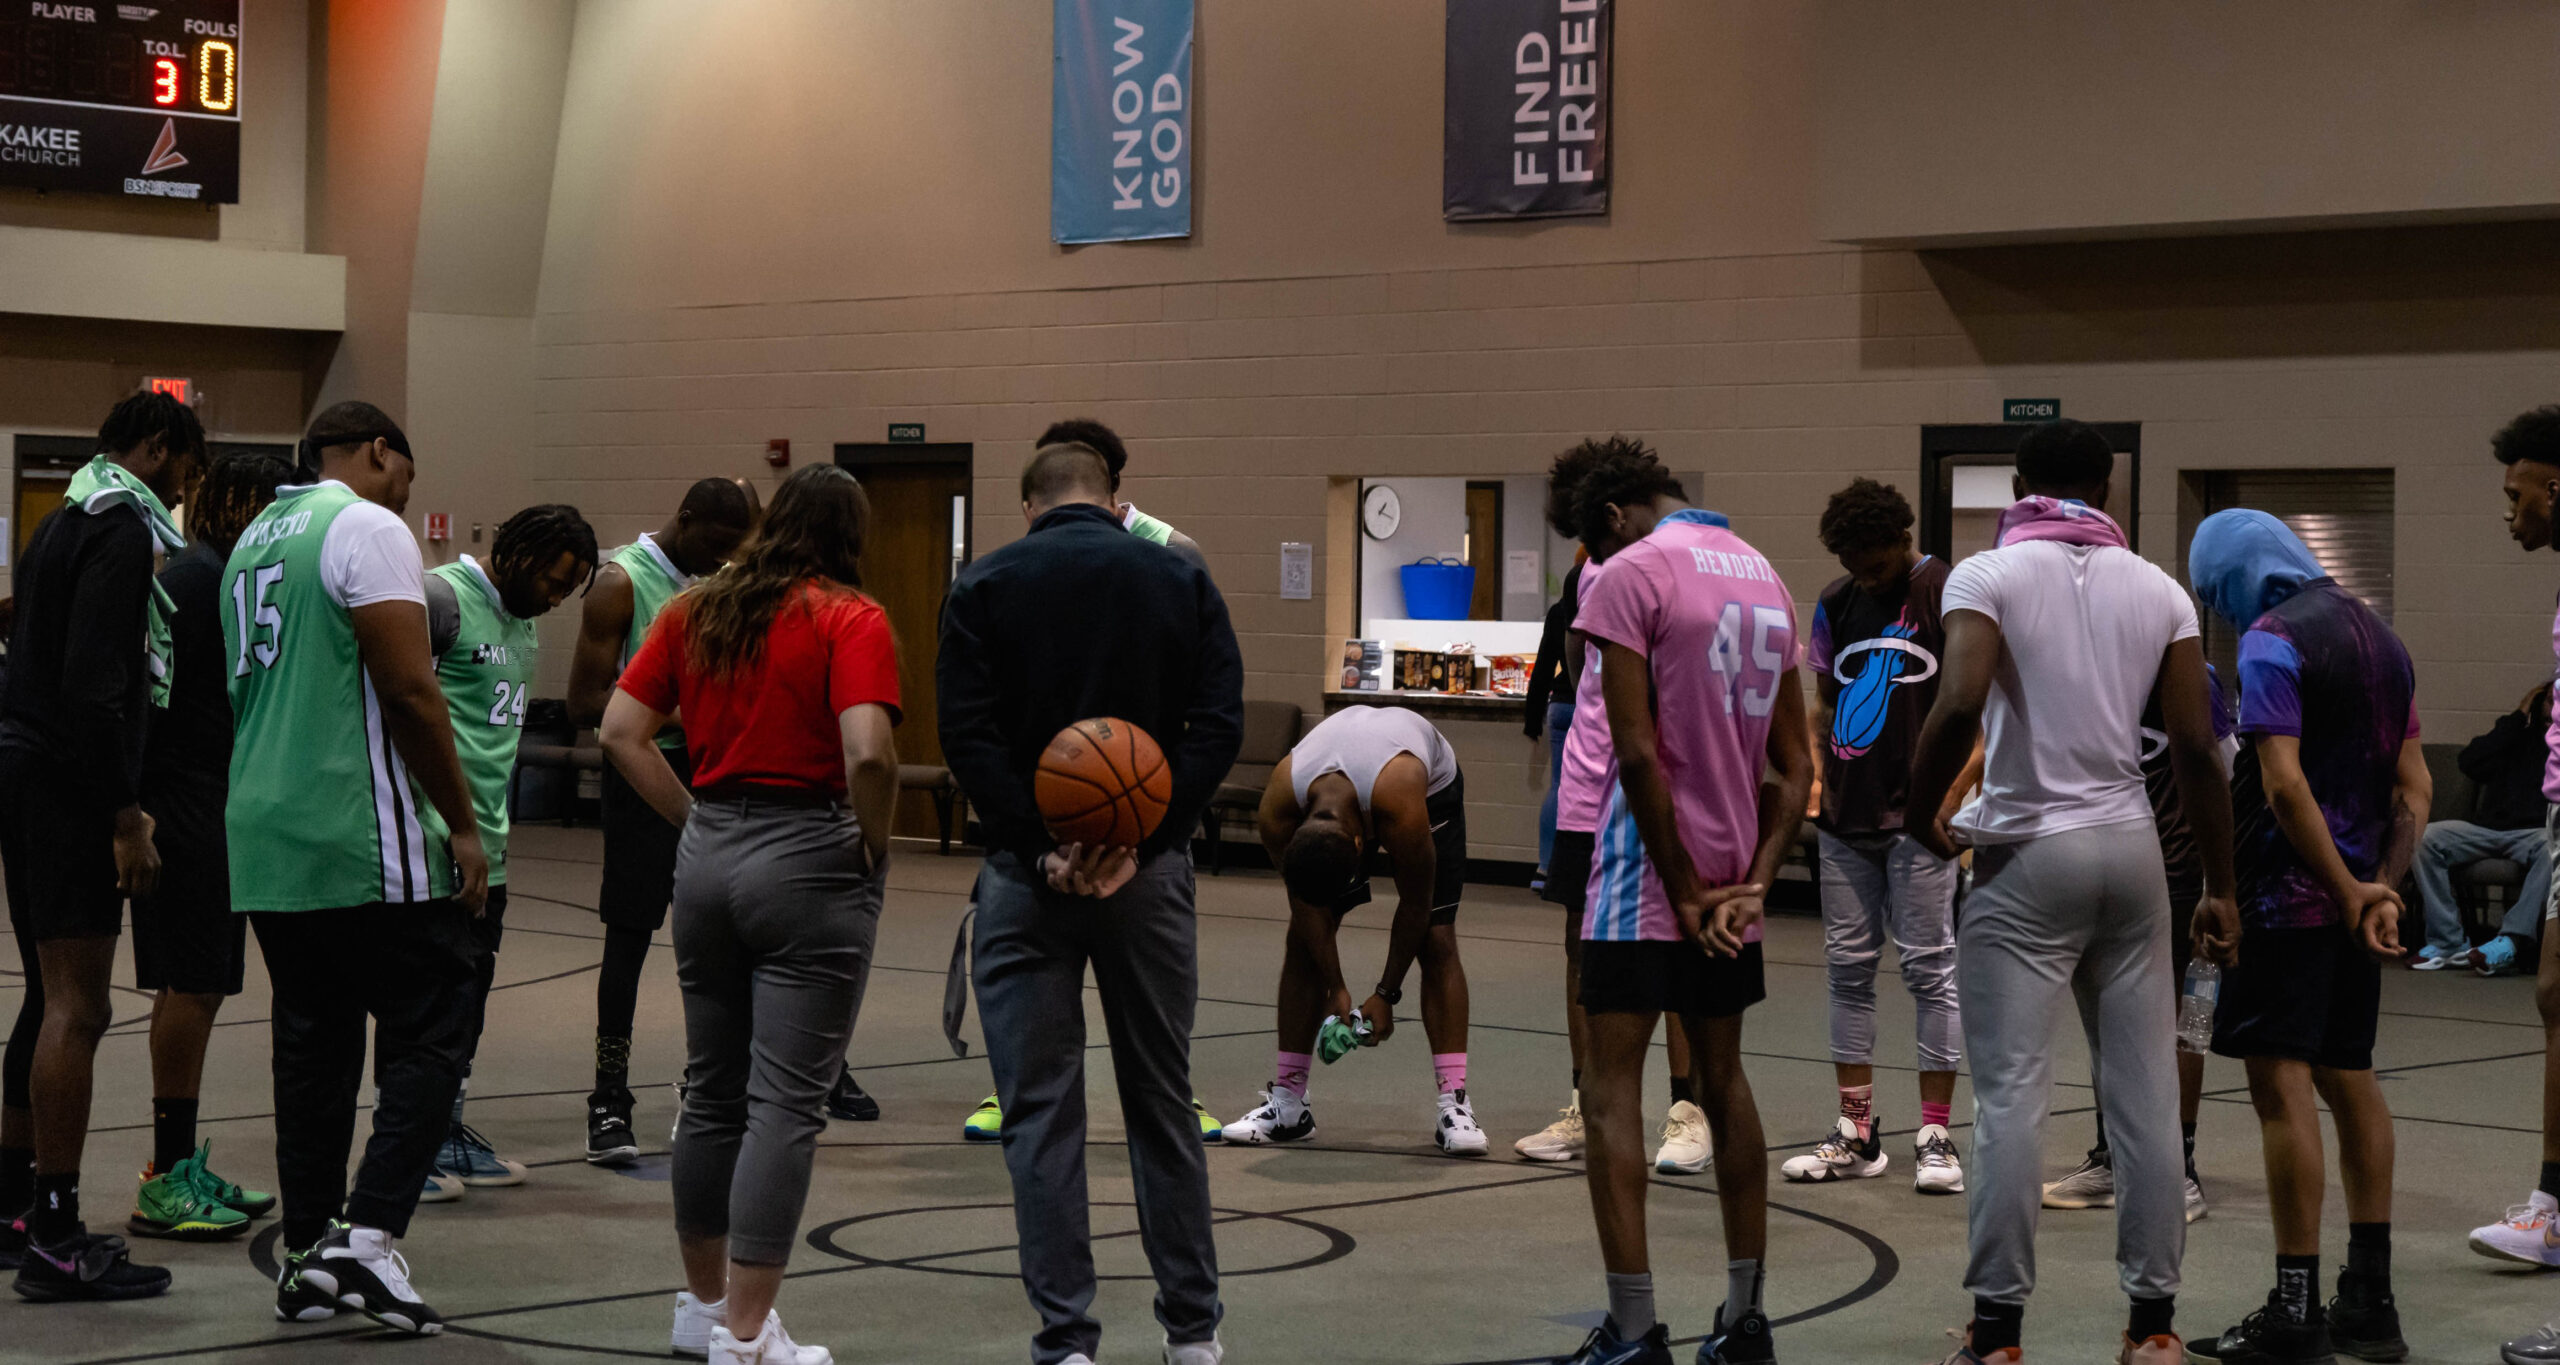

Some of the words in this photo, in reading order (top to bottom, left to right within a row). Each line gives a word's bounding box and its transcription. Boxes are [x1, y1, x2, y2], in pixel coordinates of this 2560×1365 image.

[32, 1, 97, 23] PLAYER
[184, 18, 238, 38] FOULS
[155, 60, 178, 105] 3
[200, 40, 234, 110] 0
[1112, 16, 1144, 210] KNOW
[1514, 32, 1550, 185] FIND
[0, 124, 81, 151] KAKEE
[1, 146, 80, 166] CHURCH
[1151, 73, 1183, 208] GOD
[2010, 403, 2053, 416] KITCHEN
[231, 559, 285, 680] 15
[1708, 602, 1789, 717] 45
[488, 680, 526, 727] 24
